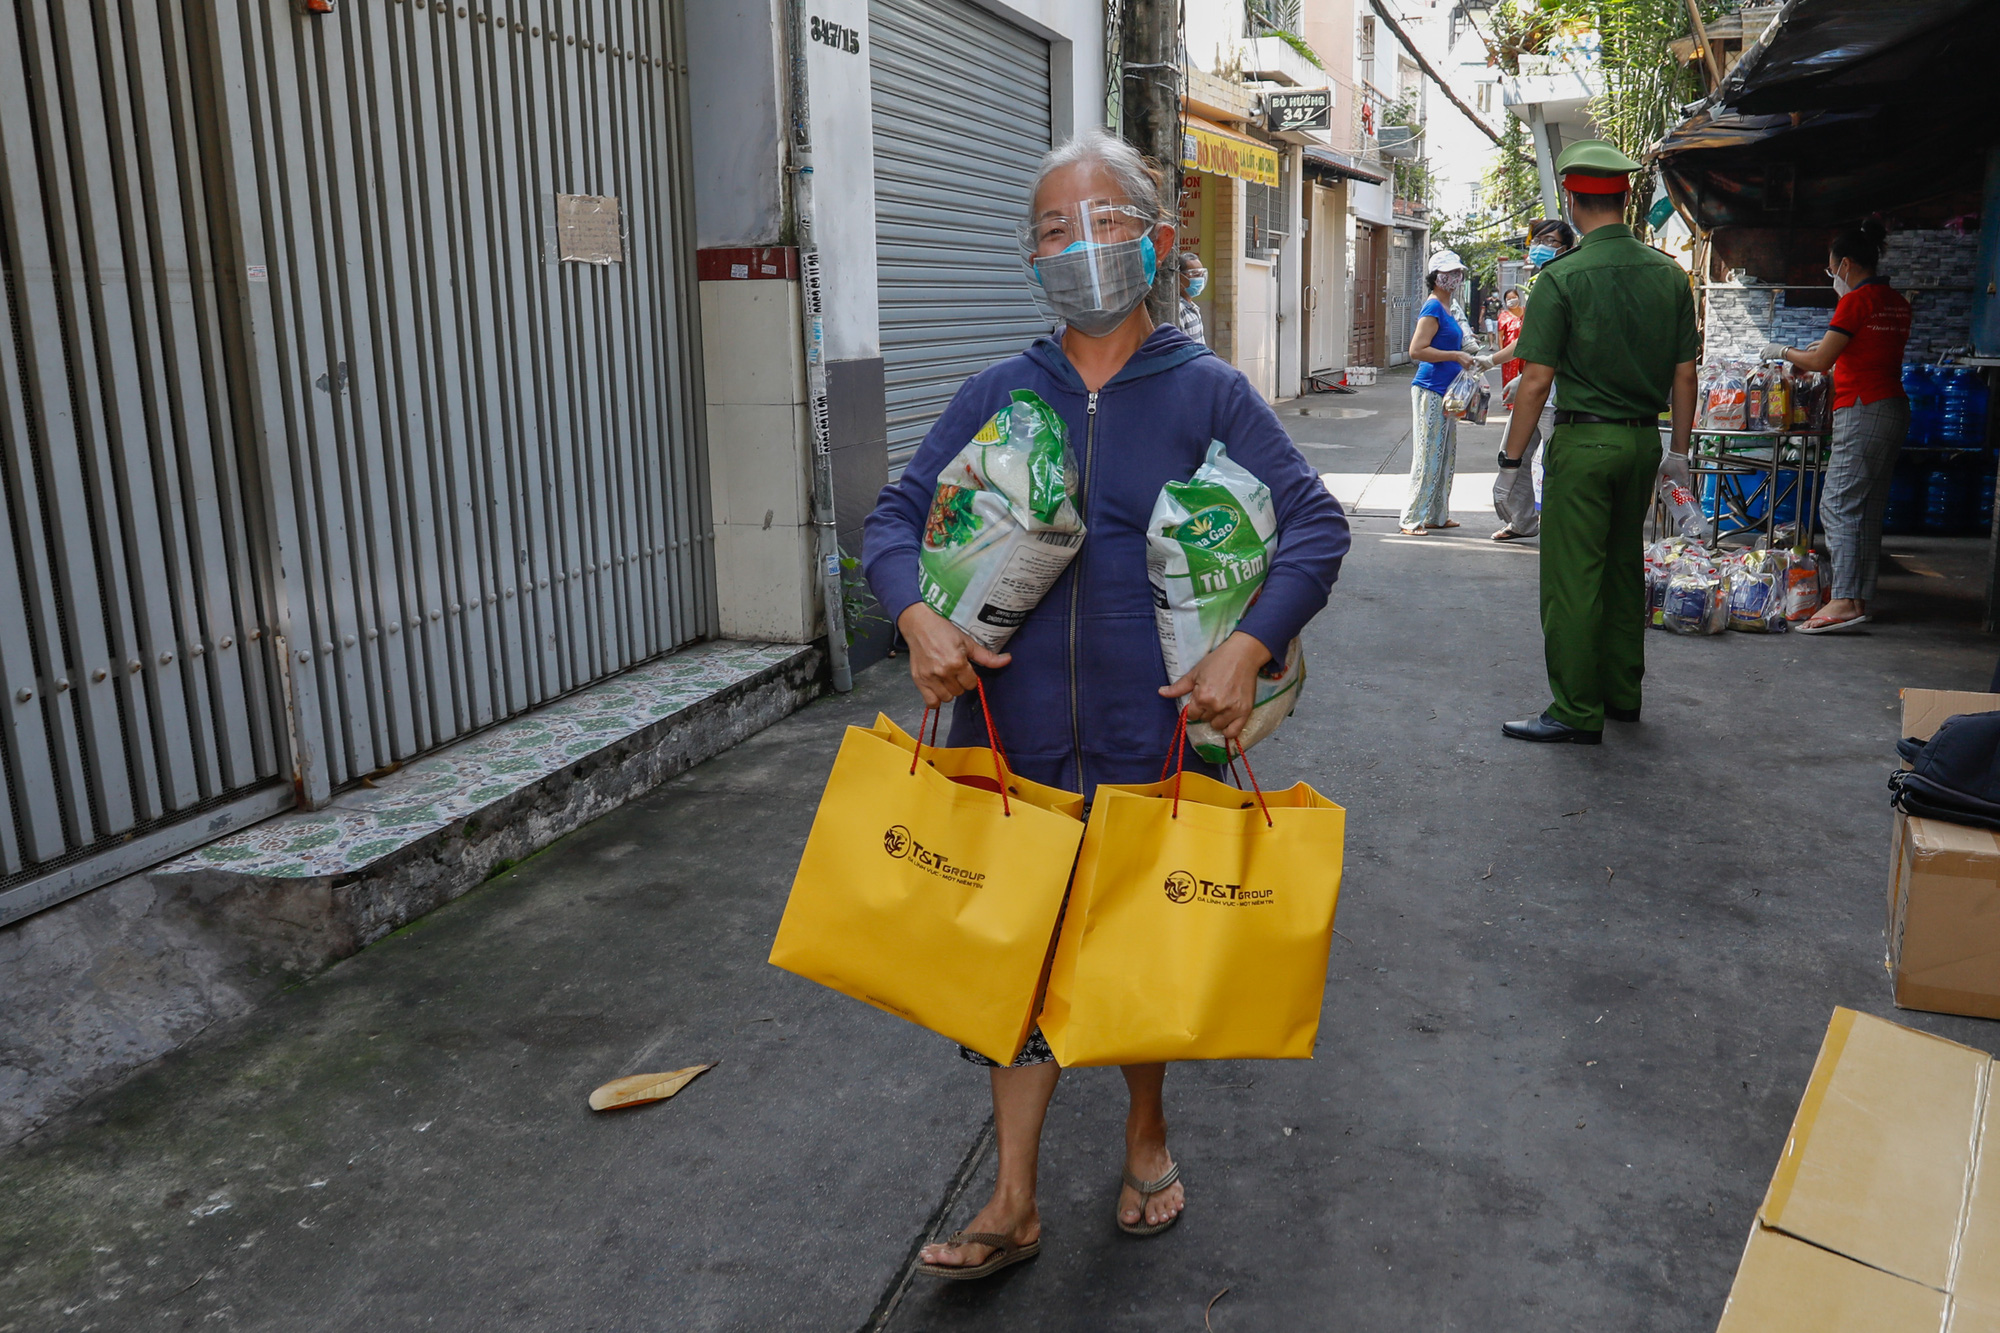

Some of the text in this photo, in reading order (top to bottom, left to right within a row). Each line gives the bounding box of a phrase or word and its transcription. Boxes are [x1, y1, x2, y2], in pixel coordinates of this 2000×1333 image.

[811, 15, 859, 54] 347/15
[1272, 95, 1287, 108] BÒ
[1282, 107, 1314, 121] 347
[1209, 523, 1233, 541] Gạo
[1200, 569, 1228, 593] Từ
[942, 864, 986, 881] GROUP
[1238, 889, 1273, 900] GROUP
